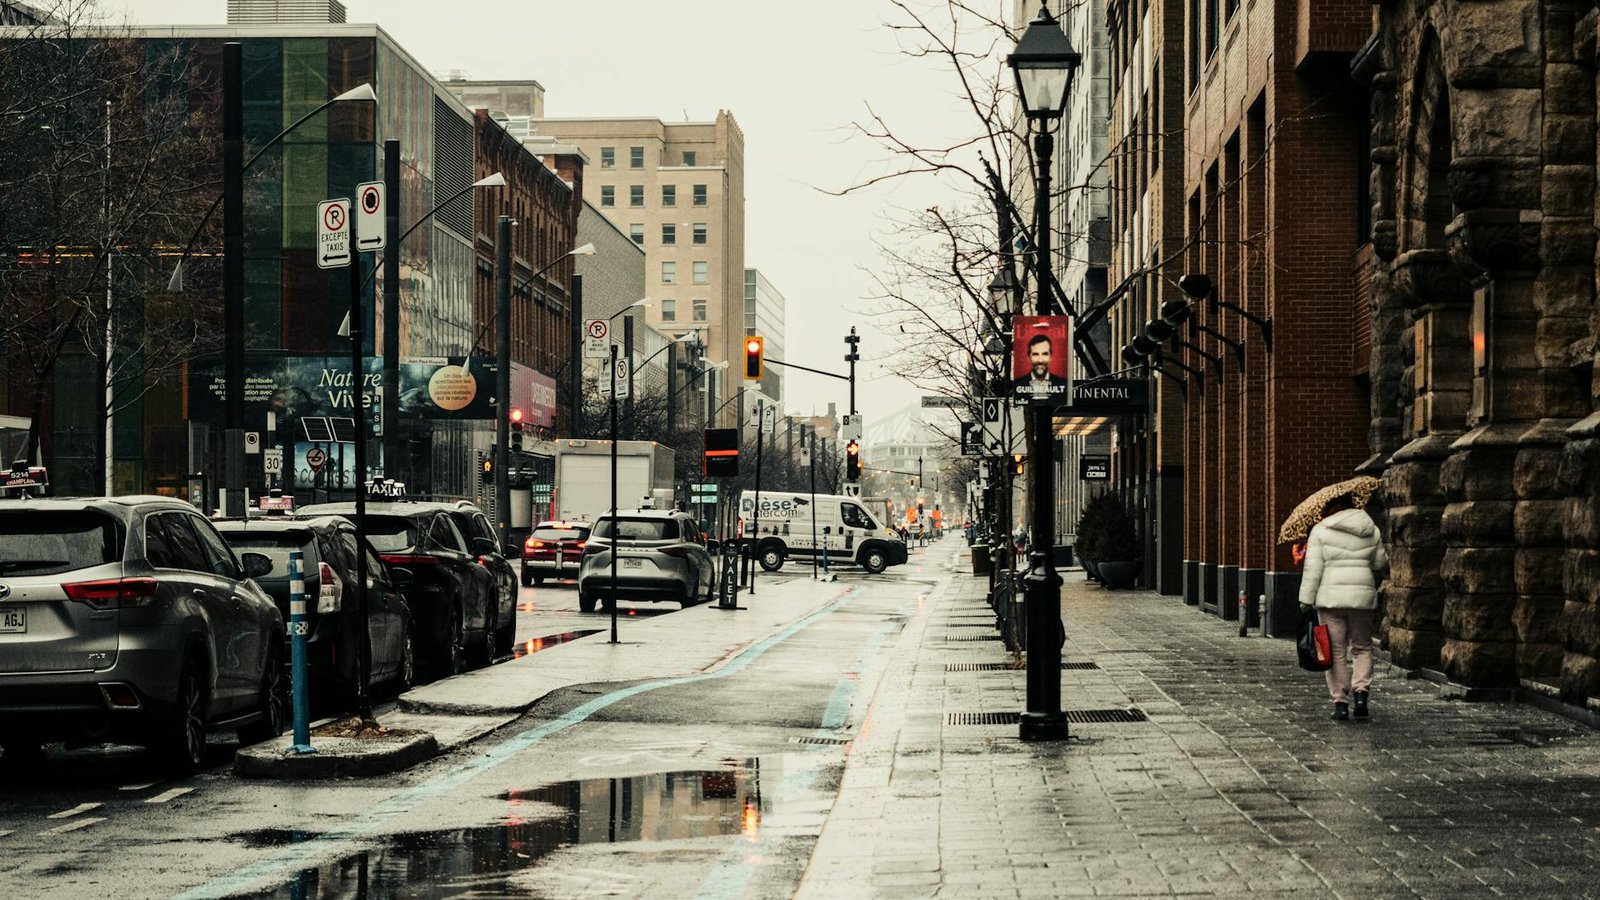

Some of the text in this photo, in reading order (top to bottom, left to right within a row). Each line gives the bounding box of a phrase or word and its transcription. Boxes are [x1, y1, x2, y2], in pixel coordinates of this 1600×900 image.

[326, 242, 345, 252] TAXIS
[318, 368, 382, 387] Natre
[1016, 385, 1066, 394] GUILBEAULT
[266, 457, 279, 471] 30
[366, 484, 392, 494] TAXI
[726, 556, 735, 604] VALET
[4, 613, 25, 627] AGJ
